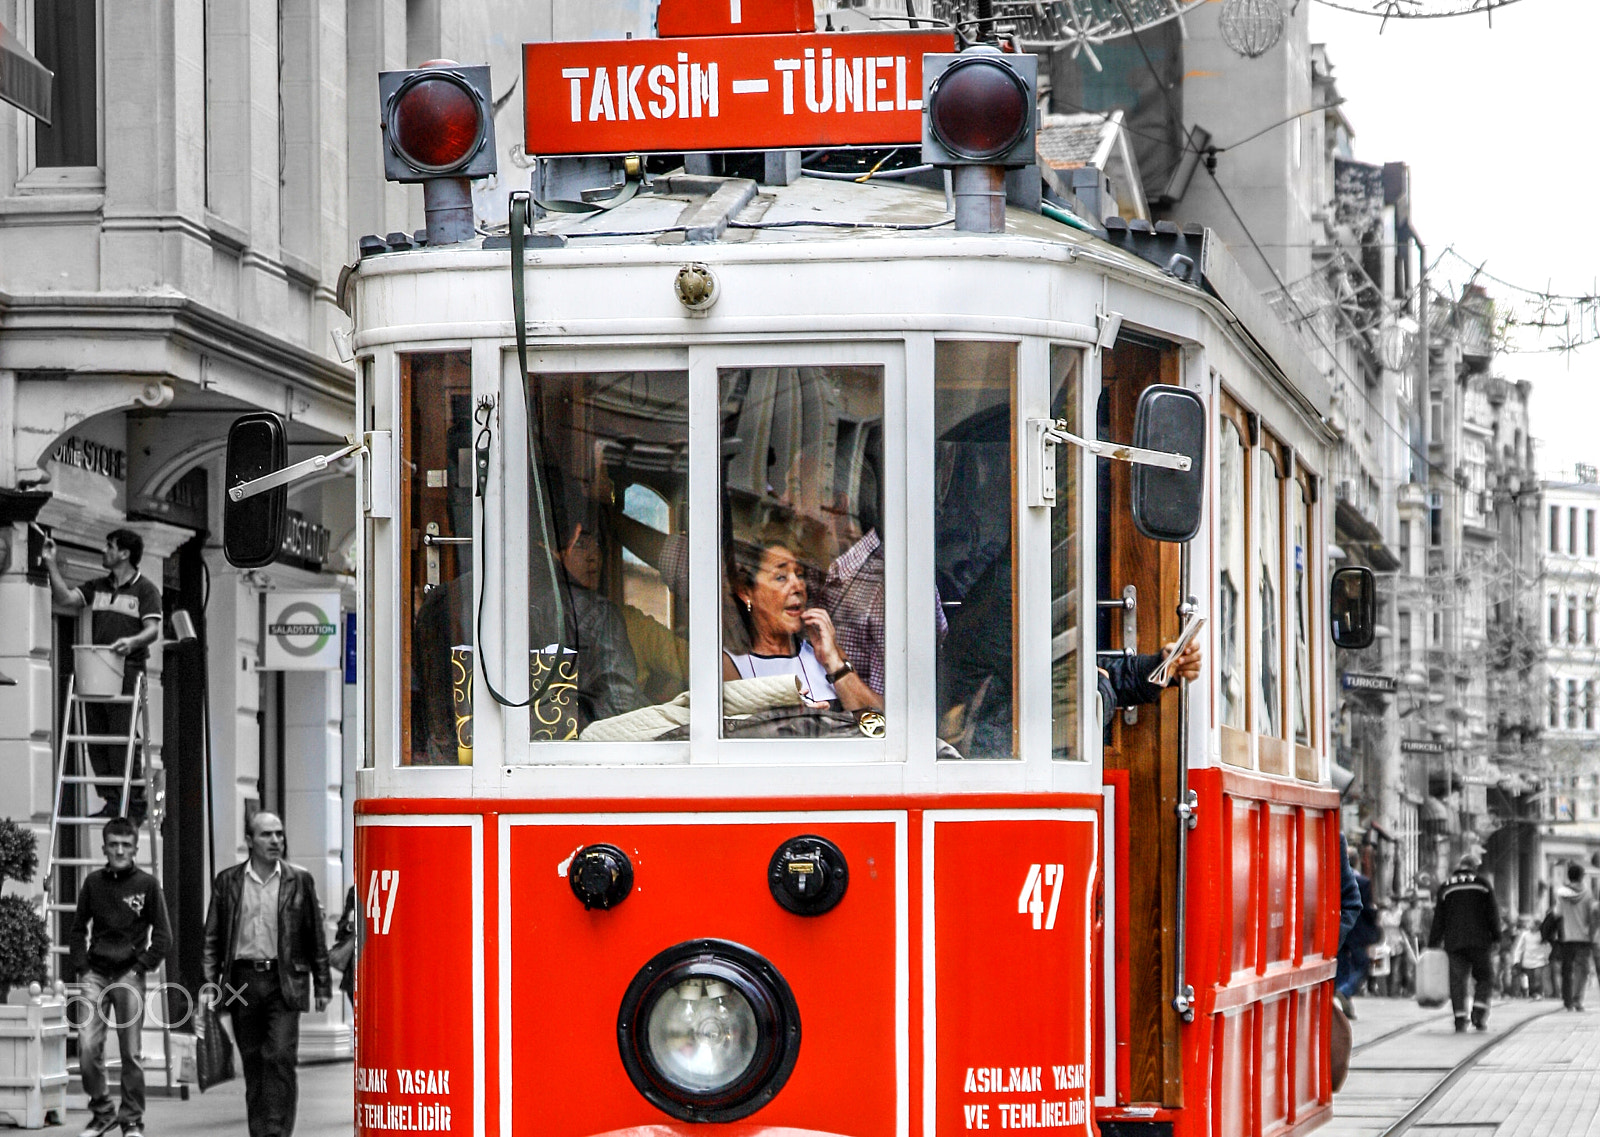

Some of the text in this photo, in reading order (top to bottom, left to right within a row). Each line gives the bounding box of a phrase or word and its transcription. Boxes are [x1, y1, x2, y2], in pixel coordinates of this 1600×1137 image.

[562, 52, 719, 122] TAKSİM
[774, 48, 923, 115] TÜNEL
[271, 625, 334, 634] SALADSTATION
[1346, 676, 1394, 690] TURKCELL
[1403, 741, 1442, 752] TURKCELL
[366, 870, 400, 935] 47
[1018, 864, 1064, 930] 47
[396, 1069, 450, 1095] YASAK
[963, 1064, 1085, 1093] ASILMAK YASAK
[364, 1101, 452, 1131] TEHLİKELİDİR
[963, 1097, 1086, 1130] VE TEHLİKELİDİR
